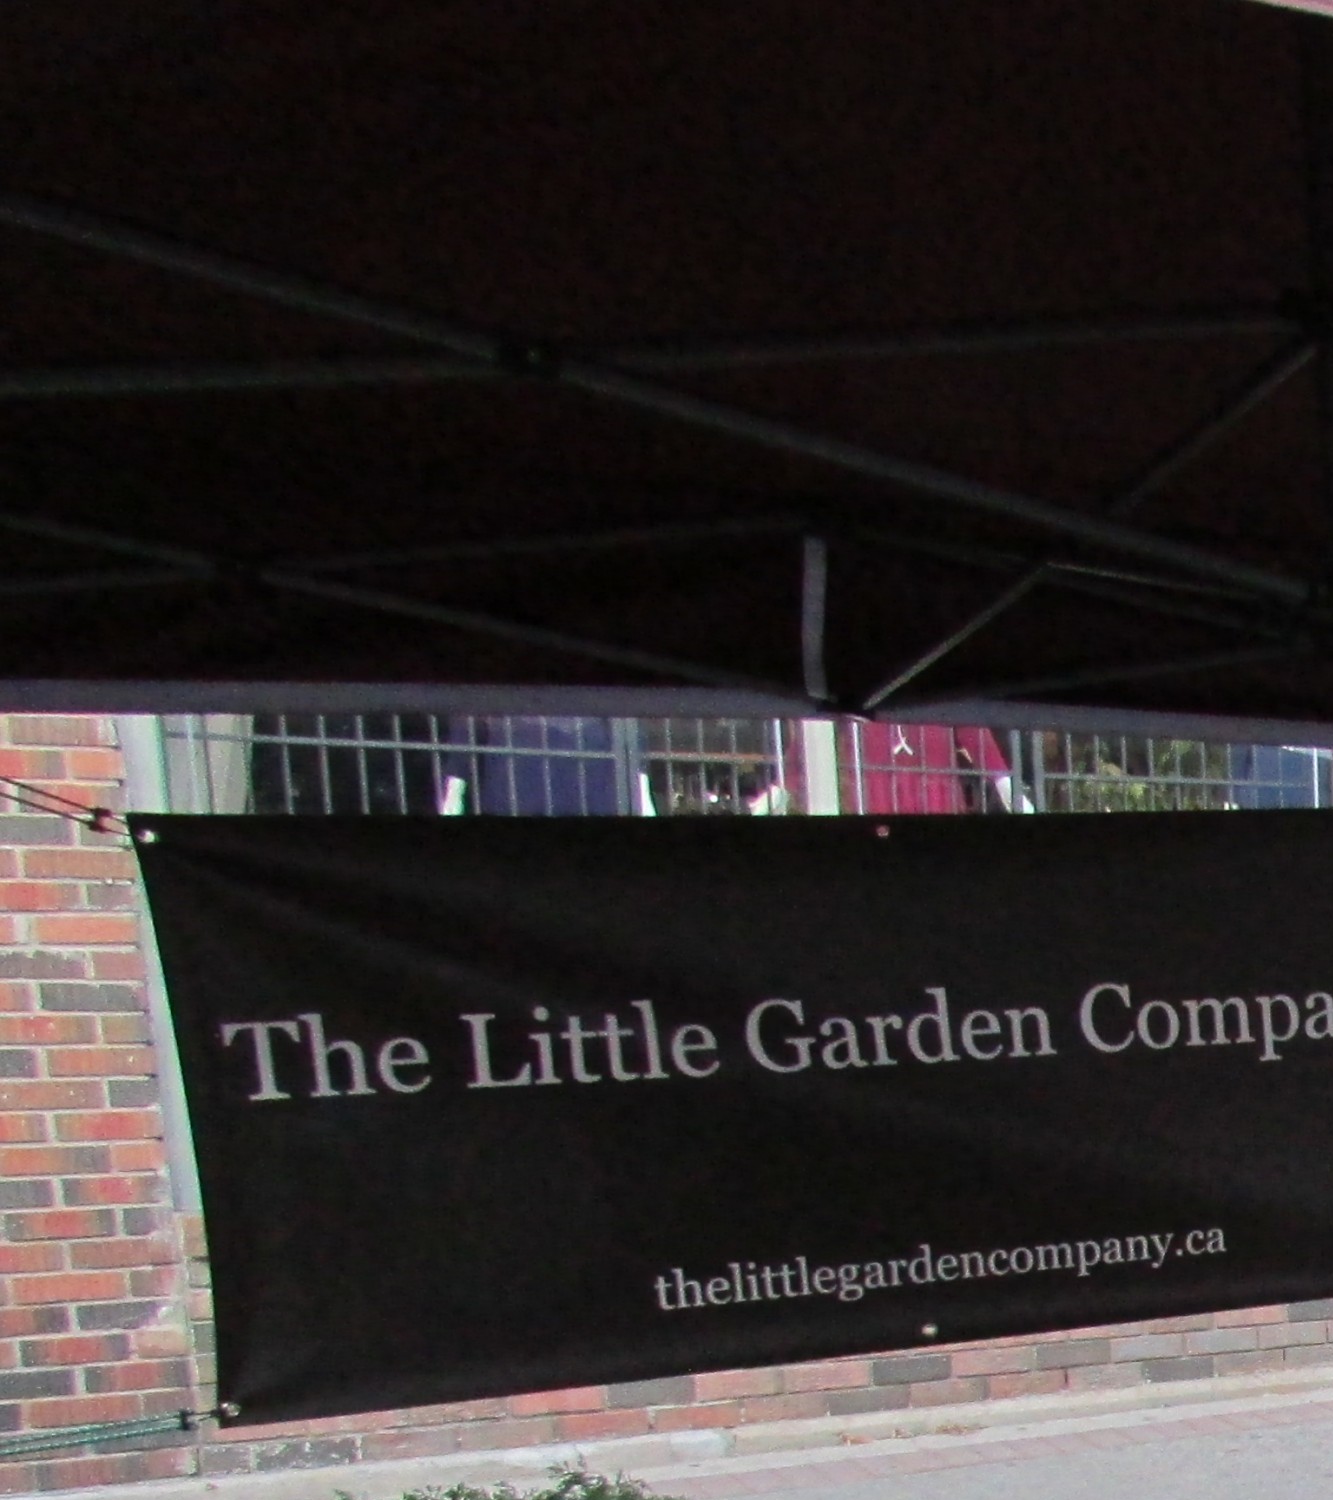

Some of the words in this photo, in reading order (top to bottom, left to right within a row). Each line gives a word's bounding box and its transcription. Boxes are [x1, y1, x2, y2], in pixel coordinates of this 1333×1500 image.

[223, 1012, 433, 1103] The
[459, 1003, 722, 1090] Little
[744, 987, 1058, 1074] Garden
[654, 1224, 1228, 1313] thelittlegardencompany.ca
